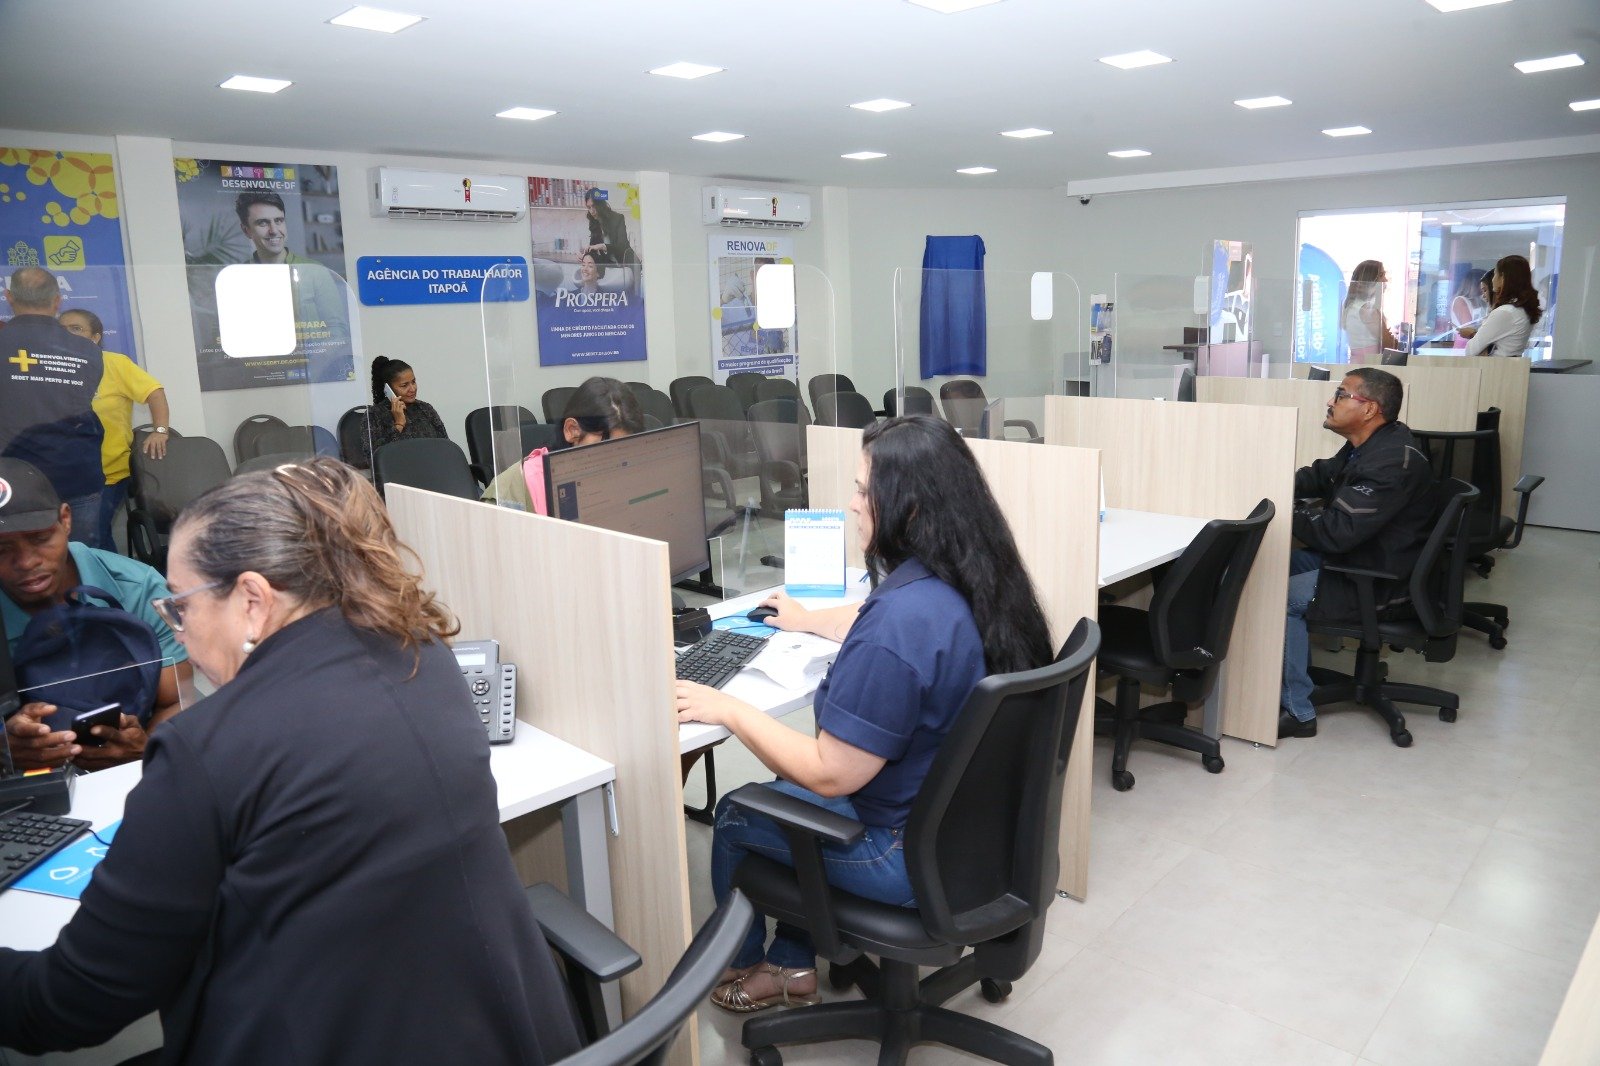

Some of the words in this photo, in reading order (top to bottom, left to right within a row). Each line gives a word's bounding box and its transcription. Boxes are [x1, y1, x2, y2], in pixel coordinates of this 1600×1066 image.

[222, 179, 296, 189] DESENVOLVE-DF
[367, 268, 420, 280] AGÊNCIA
[422, 269, 439, 279] DO
[441, 268, 522, 279] TRABALHADOR
[428, 281, 468, 294] ITAPOÃ
[31, 353, 88, 364] DESENVOLVIMENTO
[39, 360, 76, 368] ECONÔMICO
[44, 366, 76, 374] TRABALHO
